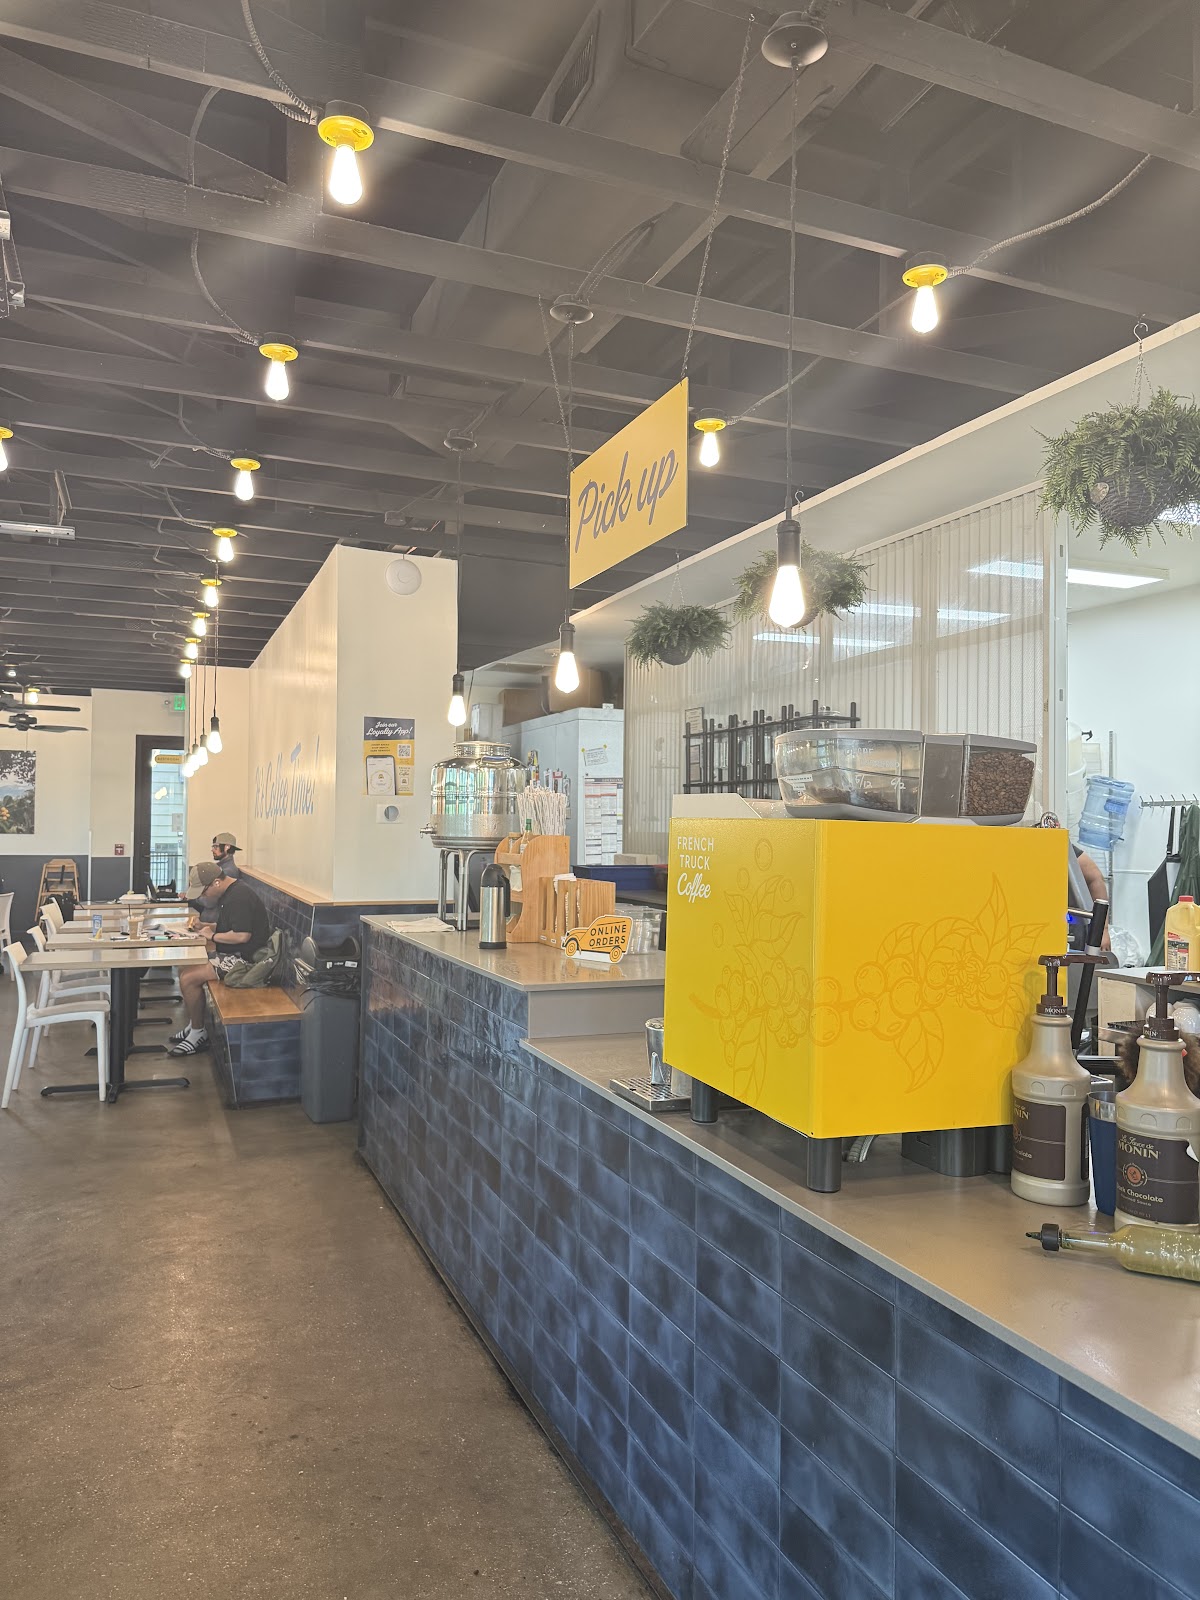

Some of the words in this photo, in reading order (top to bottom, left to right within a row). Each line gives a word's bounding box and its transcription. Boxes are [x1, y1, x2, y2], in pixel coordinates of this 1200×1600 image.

[575, 450, 633, 554] Pick
[636, 448, 679, 526] up
[366, 727, 393, 737] Loyalty
[393, 726, 414, 736] App!
[375, 721, 388, 729] Join
[264, 751, 289, 835] Coffee
[289, 734, 320, 818] Time!
[854, 774, 873, 789] 5/12
[677, 836, 714, 851] FRENCH
[679, 854, 710, 871] TRUCK
[677, 872, 711, 904] Coffee
[590, 924, 627, 937] ONLINE
[588, 935, 626, 947] ORDERS
[1118, 1139, 1159, 1159] MONIN
[1126, 1188, 1164, 1203] Chocolate
